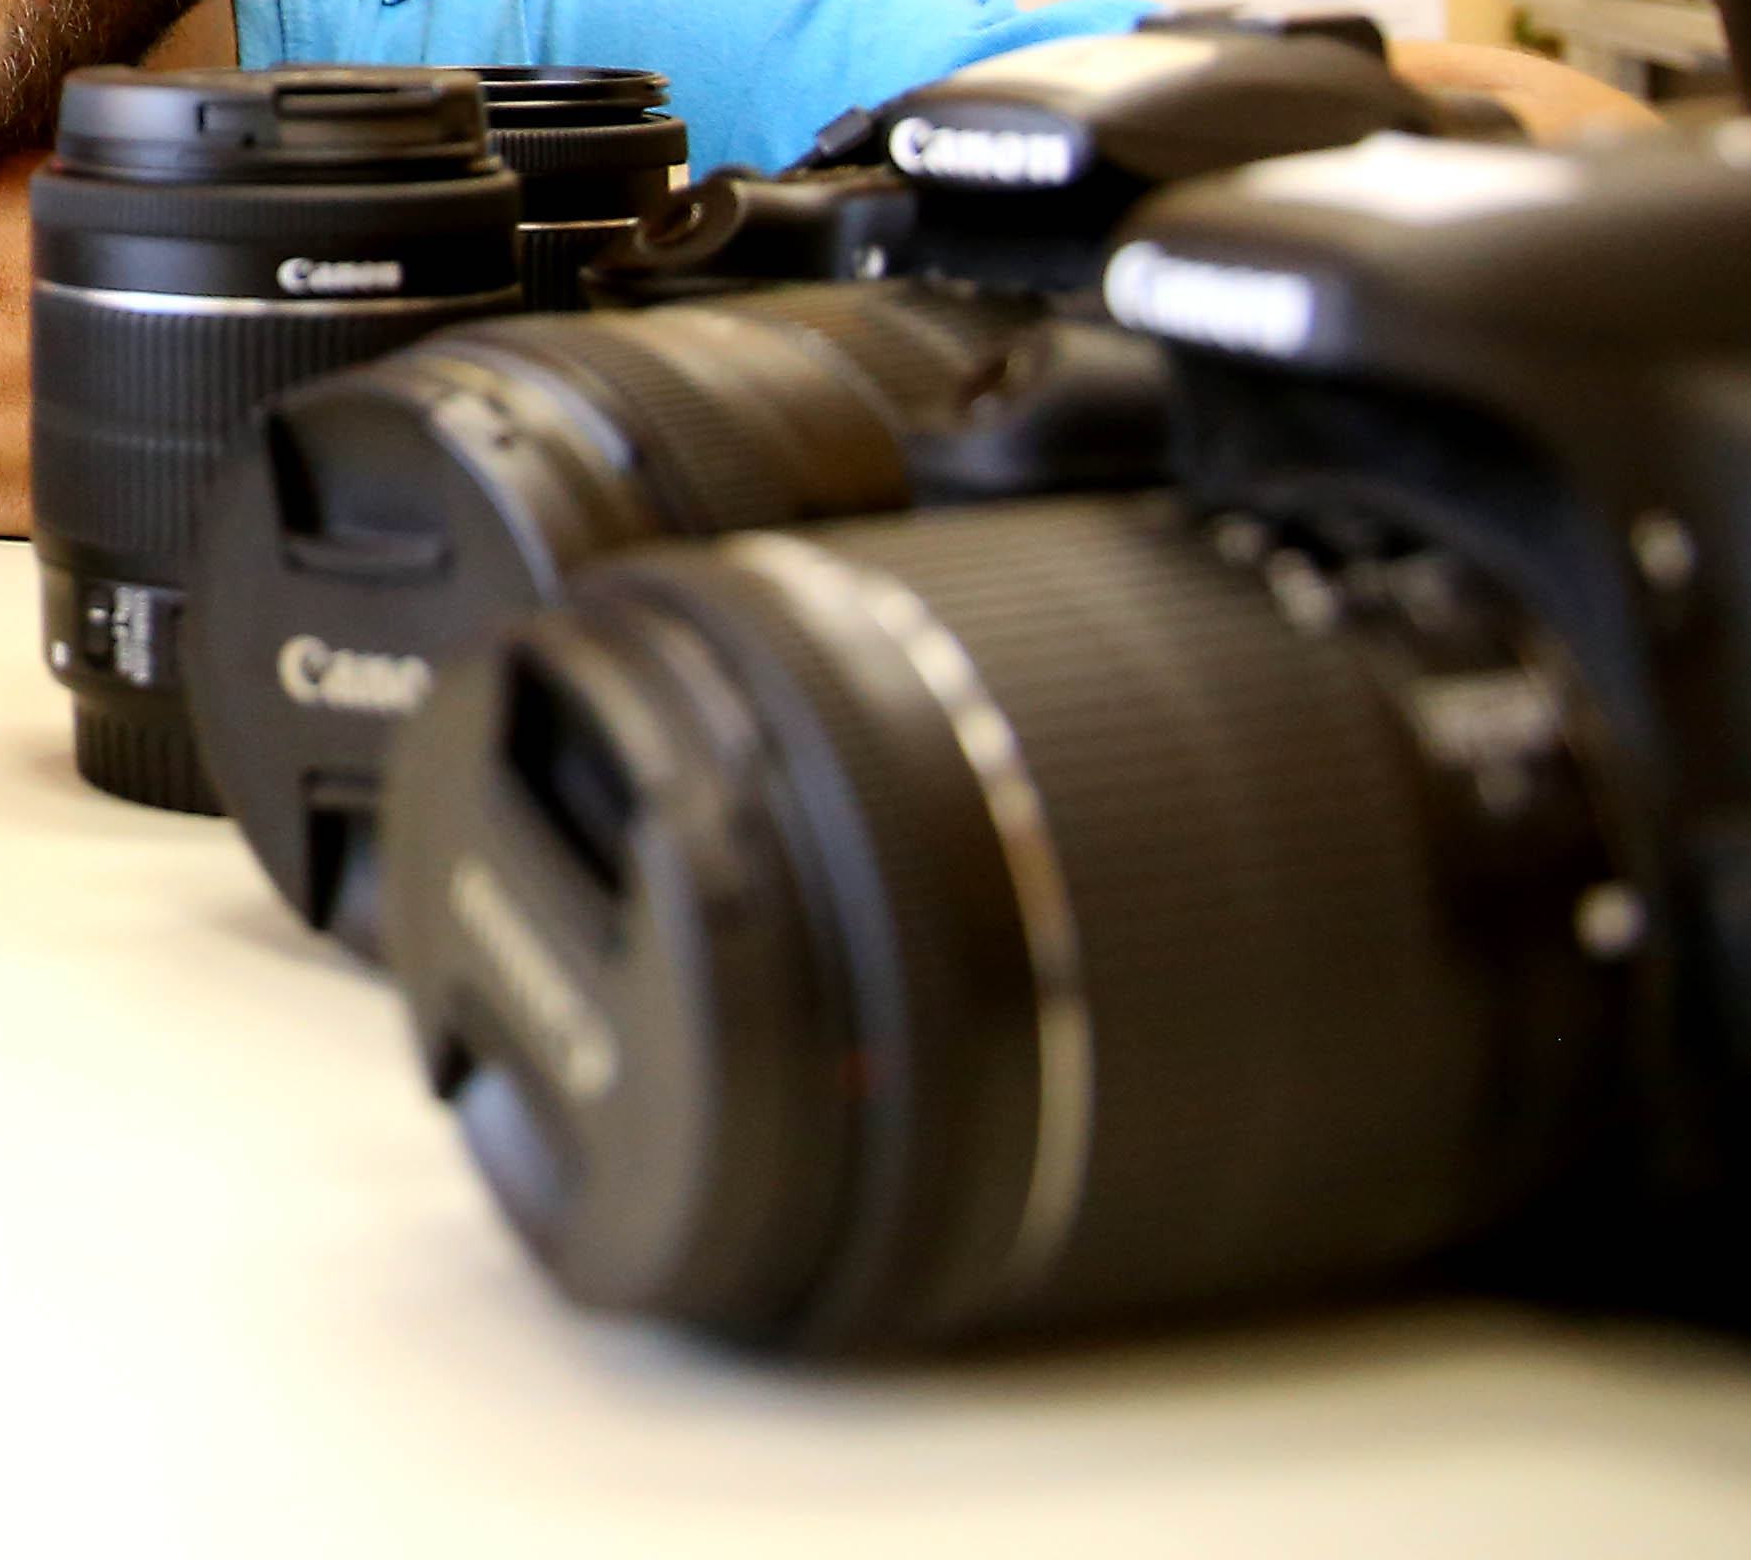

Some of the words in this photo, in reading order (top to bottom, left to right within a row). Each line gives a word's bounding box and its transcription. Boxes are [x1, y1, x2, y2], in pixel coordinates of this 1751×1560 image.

[888, 116, 1072, 185] Canon
[275, 257, 404, 294] Canon
[276, 635, 433, 711] Cano
